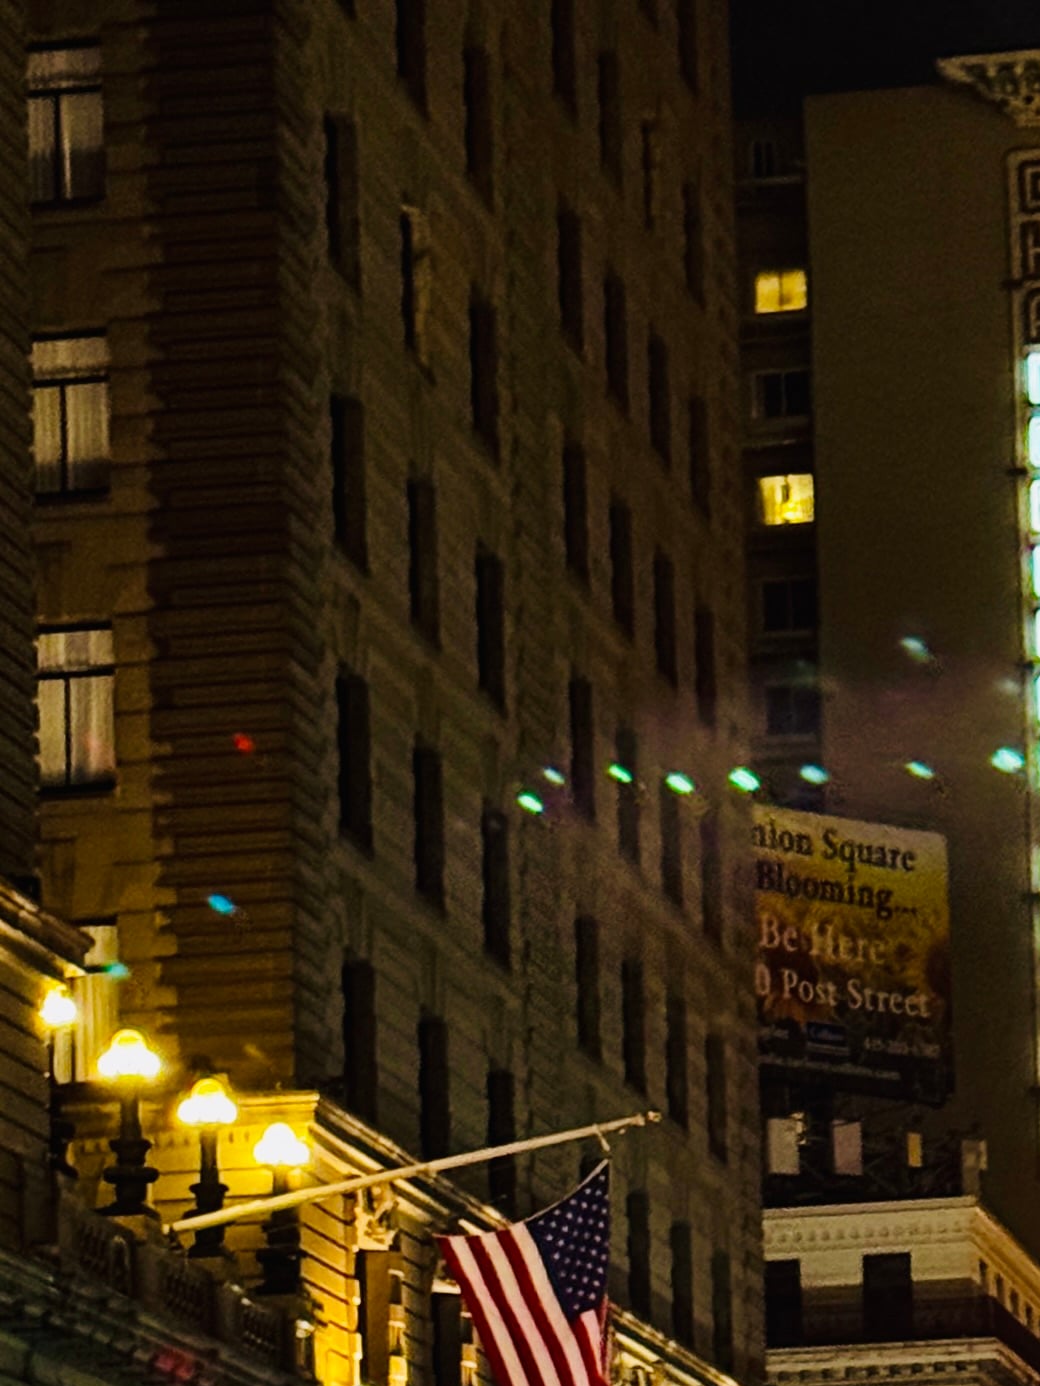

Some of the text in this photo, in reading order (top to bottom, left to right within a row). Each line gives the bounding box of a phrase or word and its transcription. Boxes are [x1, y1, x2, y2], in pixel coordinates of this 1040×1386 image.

[753, 820, 917, 873] nion Square
[760, 914, 798, 951] Be
[781, 968, 838, 1007] Post
[847, 978, 931, 1018] Street
